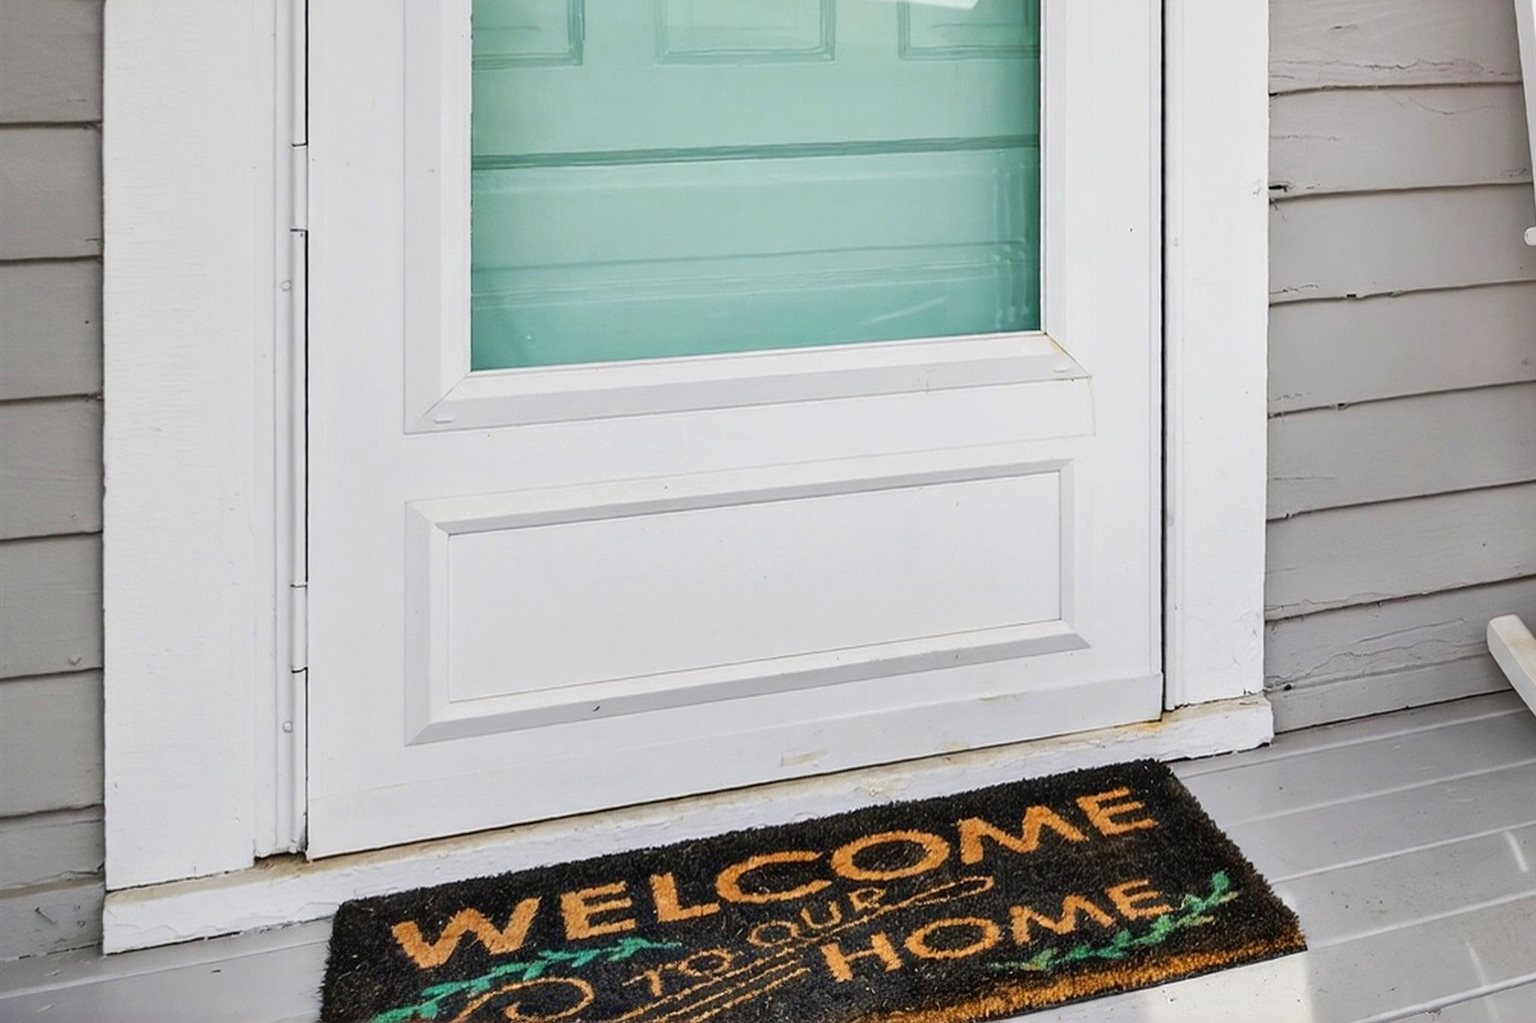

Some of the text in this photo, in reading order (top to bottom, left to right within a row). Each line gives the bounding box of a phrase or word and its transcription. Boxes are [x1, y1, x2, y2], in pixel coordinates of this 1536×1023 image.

[391, 787, 1160, 970] WELCOME
[820, 879, 1175, 983] HOME
[622, 886, 887, 998] TO OUR
